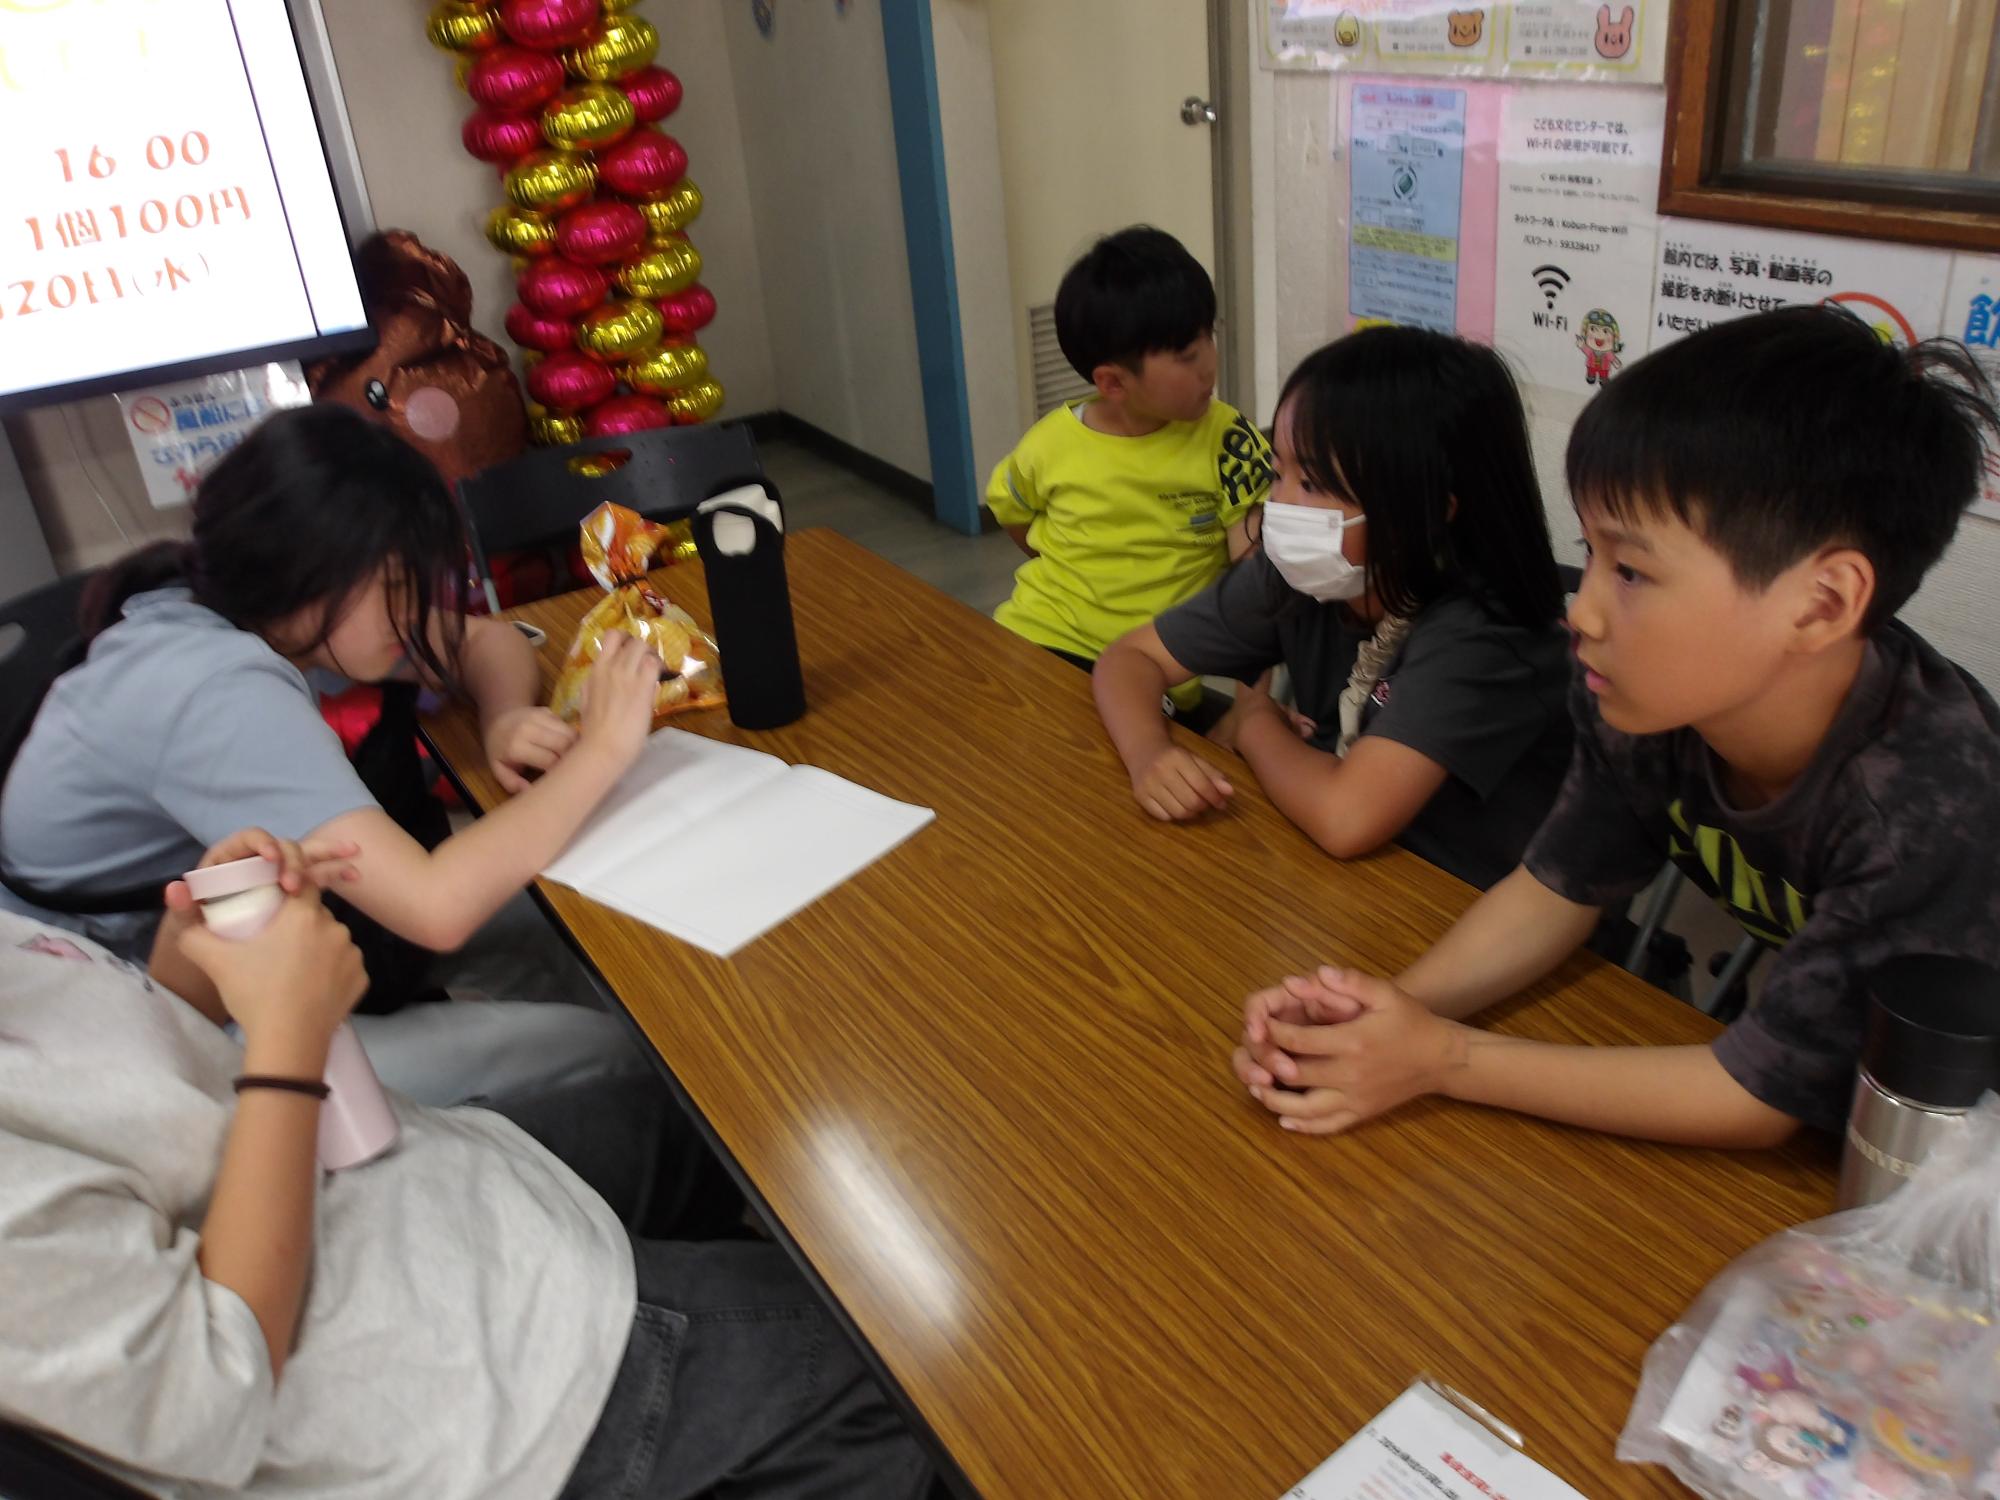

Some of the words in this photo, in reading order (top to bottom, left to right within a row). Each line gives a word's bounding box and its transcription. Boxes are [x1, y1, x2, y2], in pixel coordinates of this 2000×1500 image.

[1533, 118, 1629, 135] こども文化センターでは、
[1533, 311, 1569, 332] Wi-Fi
